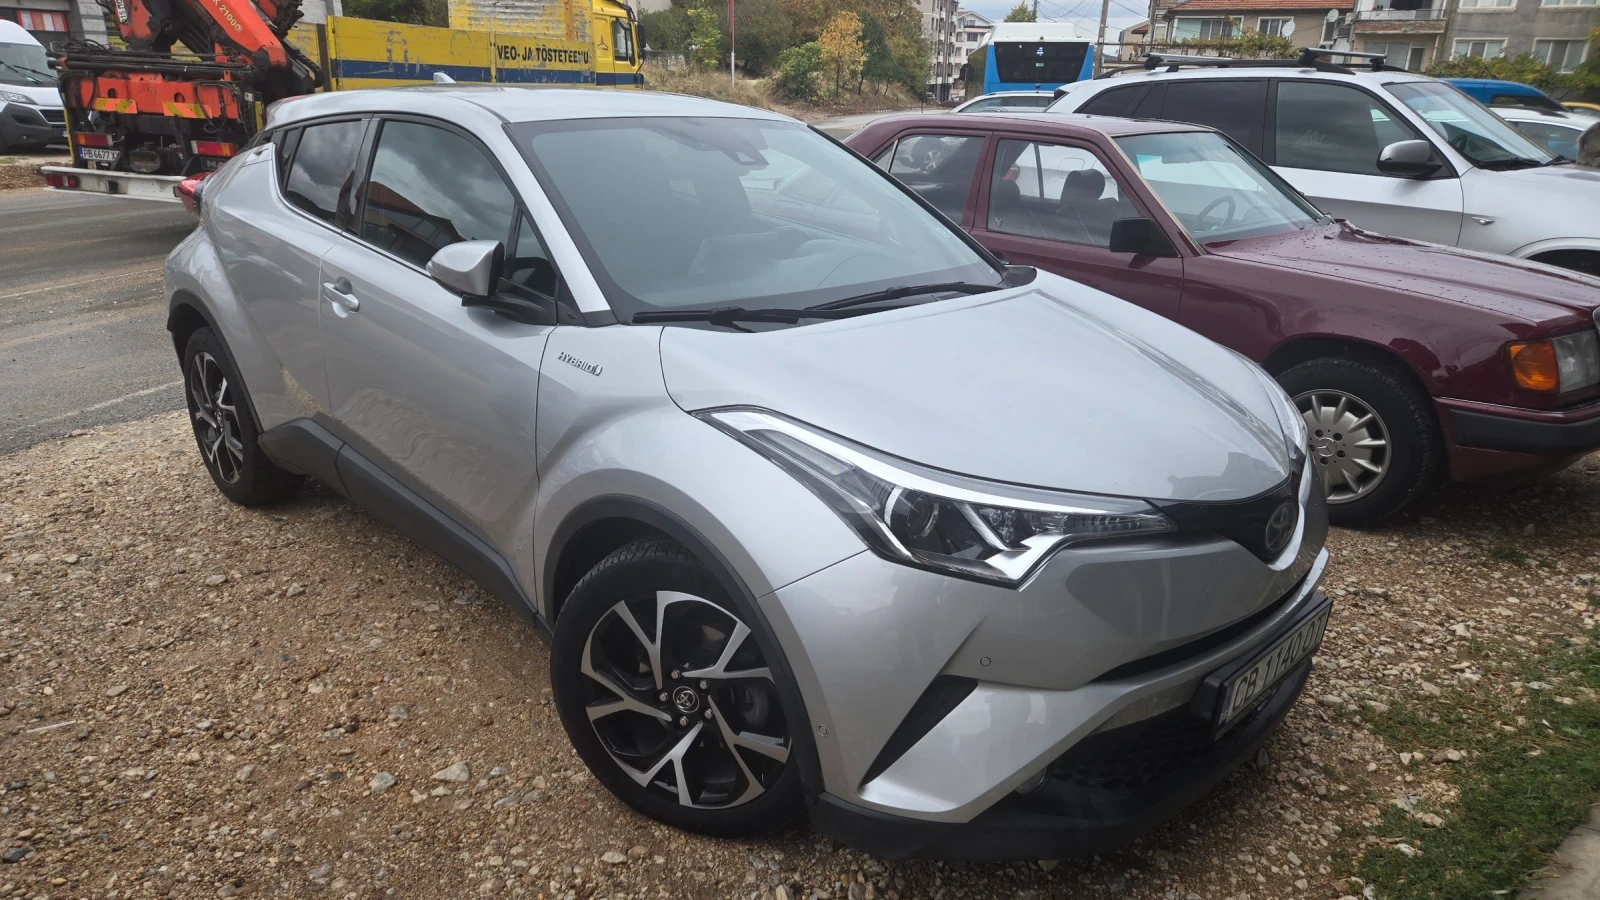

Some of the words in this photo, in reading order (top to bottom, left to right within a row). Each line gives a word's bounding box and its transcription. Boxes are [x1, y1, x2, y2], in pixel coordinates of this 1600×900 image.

[219, 4, 241, 31] 21000
[535, 44, 589, 64] TÕSTETEEU
[1036, 46, 1044, 57] 4
[84, 148, 93, 158] PB
[94, 149, 109, 159] 6677
[557, 351, 594, 374] HYBRID
[1232, 666, 1259, 712] CB
[1262, 631, 1302, 689] 1140
